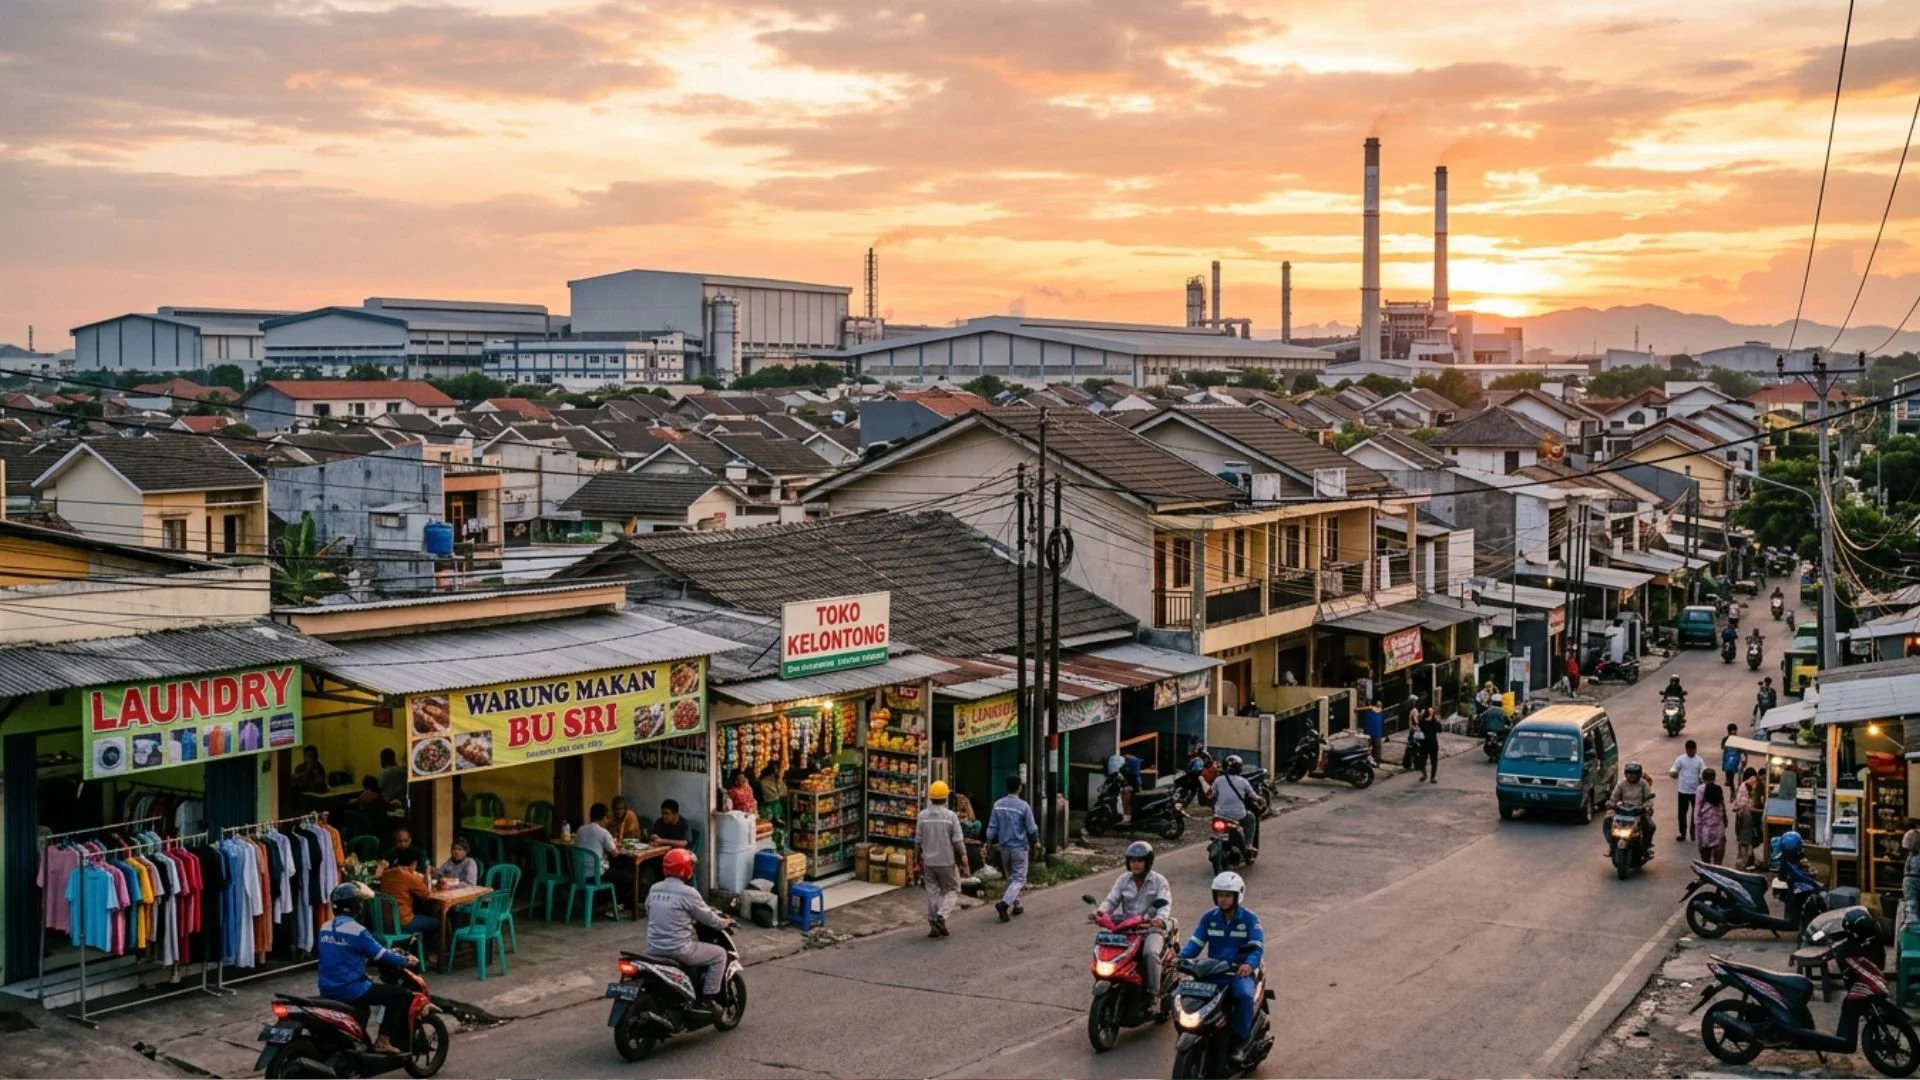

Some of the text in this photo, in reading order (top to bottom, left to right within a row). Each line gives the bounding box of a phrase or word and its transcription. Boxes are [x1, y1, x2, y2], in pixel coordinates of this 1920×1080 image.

[816, 602, 860, 626] TOKO
[787, 623, 885, 656] KELONTONG
[91, 667, 295, 732] LAUNDRY
[465, 670, 656, 716] WARUNG MAKAN
[508, 703, 618, 748] BU SRI
